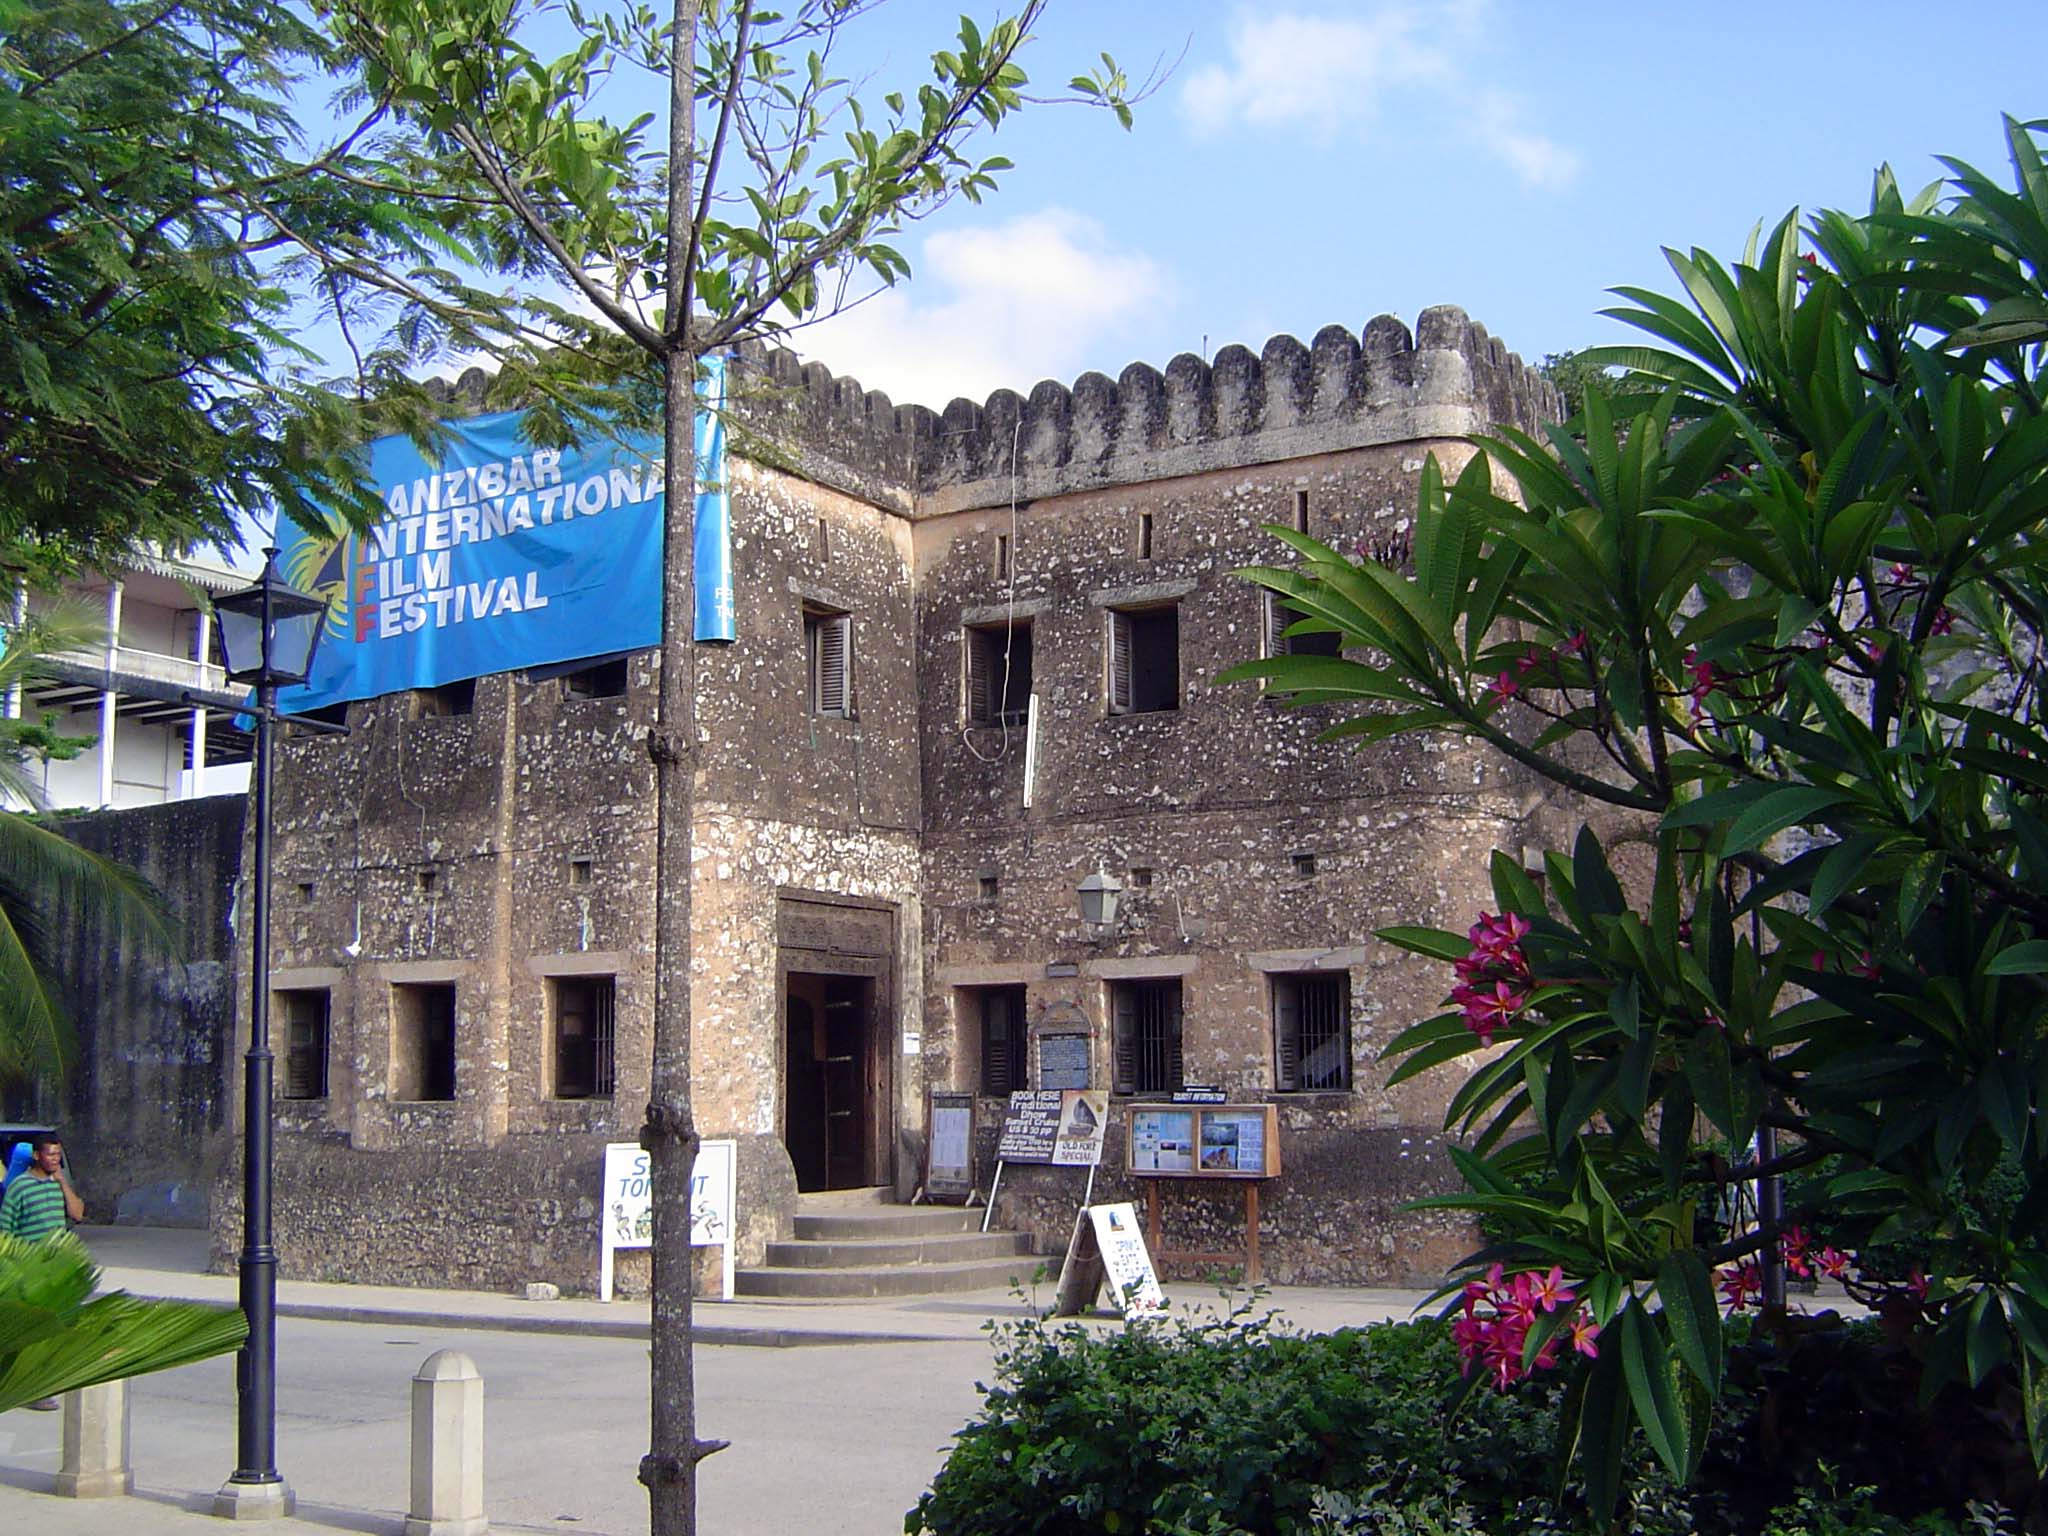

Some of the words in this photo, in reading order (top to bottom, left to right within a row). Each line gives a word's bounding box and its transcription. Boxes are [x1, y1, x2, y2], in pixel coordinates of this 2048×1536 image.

[376, 449, 561, 518] ANZIBAR
[355, 550, 451, 603] FILM
[354, 570, 549, 644] FESTIVAL
[1010, 1101, 1061, 1111] Traditional
[1011, 1091, 1035, 1101] BOOK
[1037, 1091, 1060, 1101] HERE
[1020, 1110, 1048, 1120] Dhow
